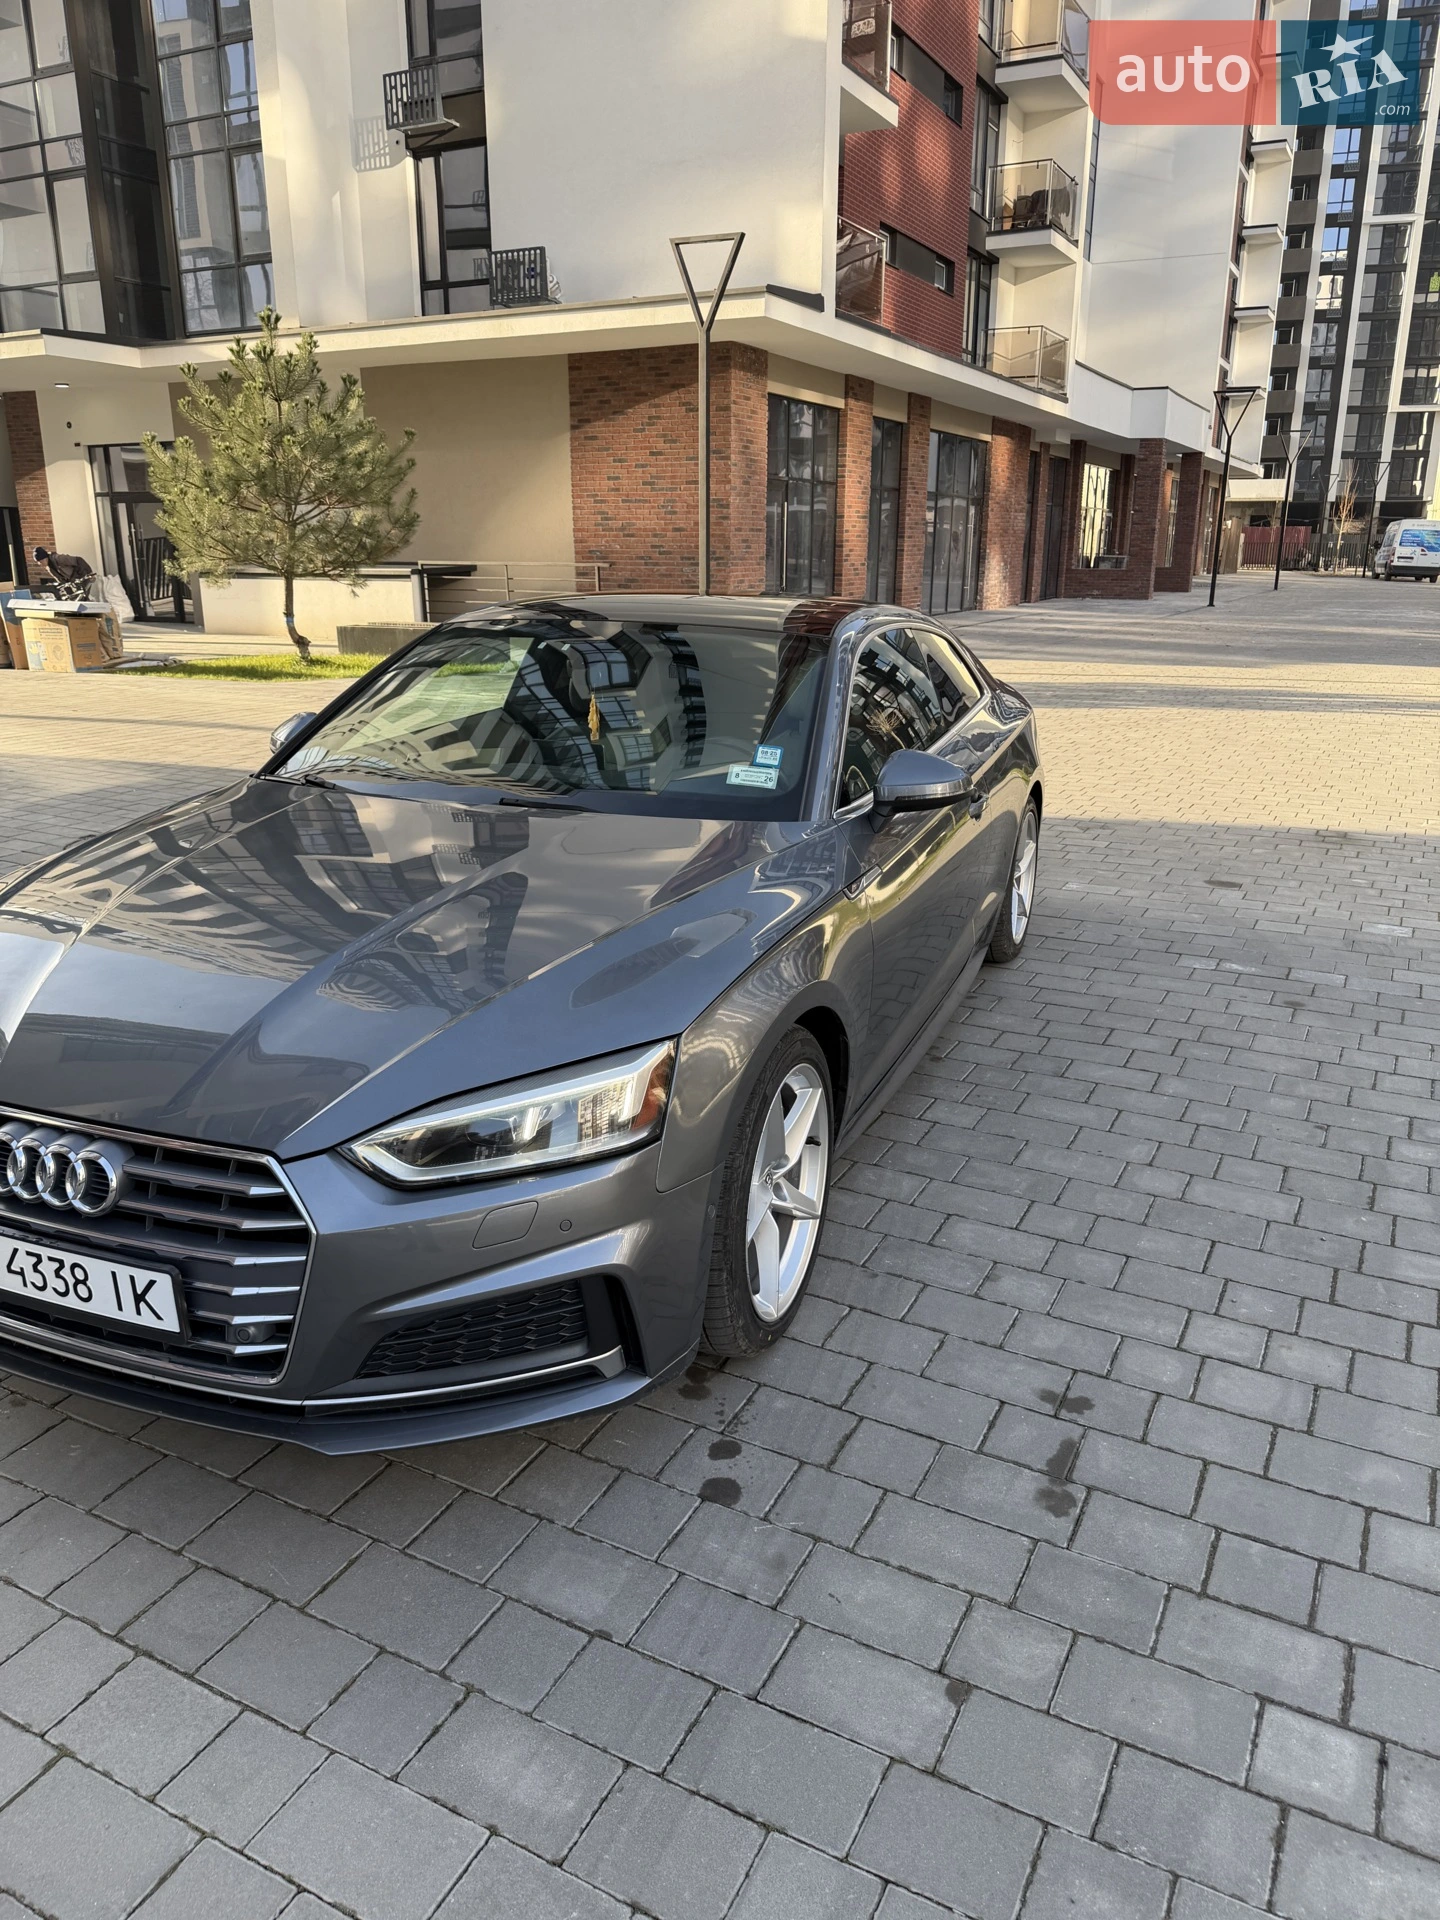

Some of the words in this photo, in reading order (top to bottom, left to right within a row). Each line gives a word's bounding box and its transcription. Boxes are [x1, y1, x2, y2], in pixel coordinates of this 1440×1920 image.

[763, 775, 773, 783] 26
[6, 1247, 93, 1303] 4338
[110, 1270, 164, 1321] IK
